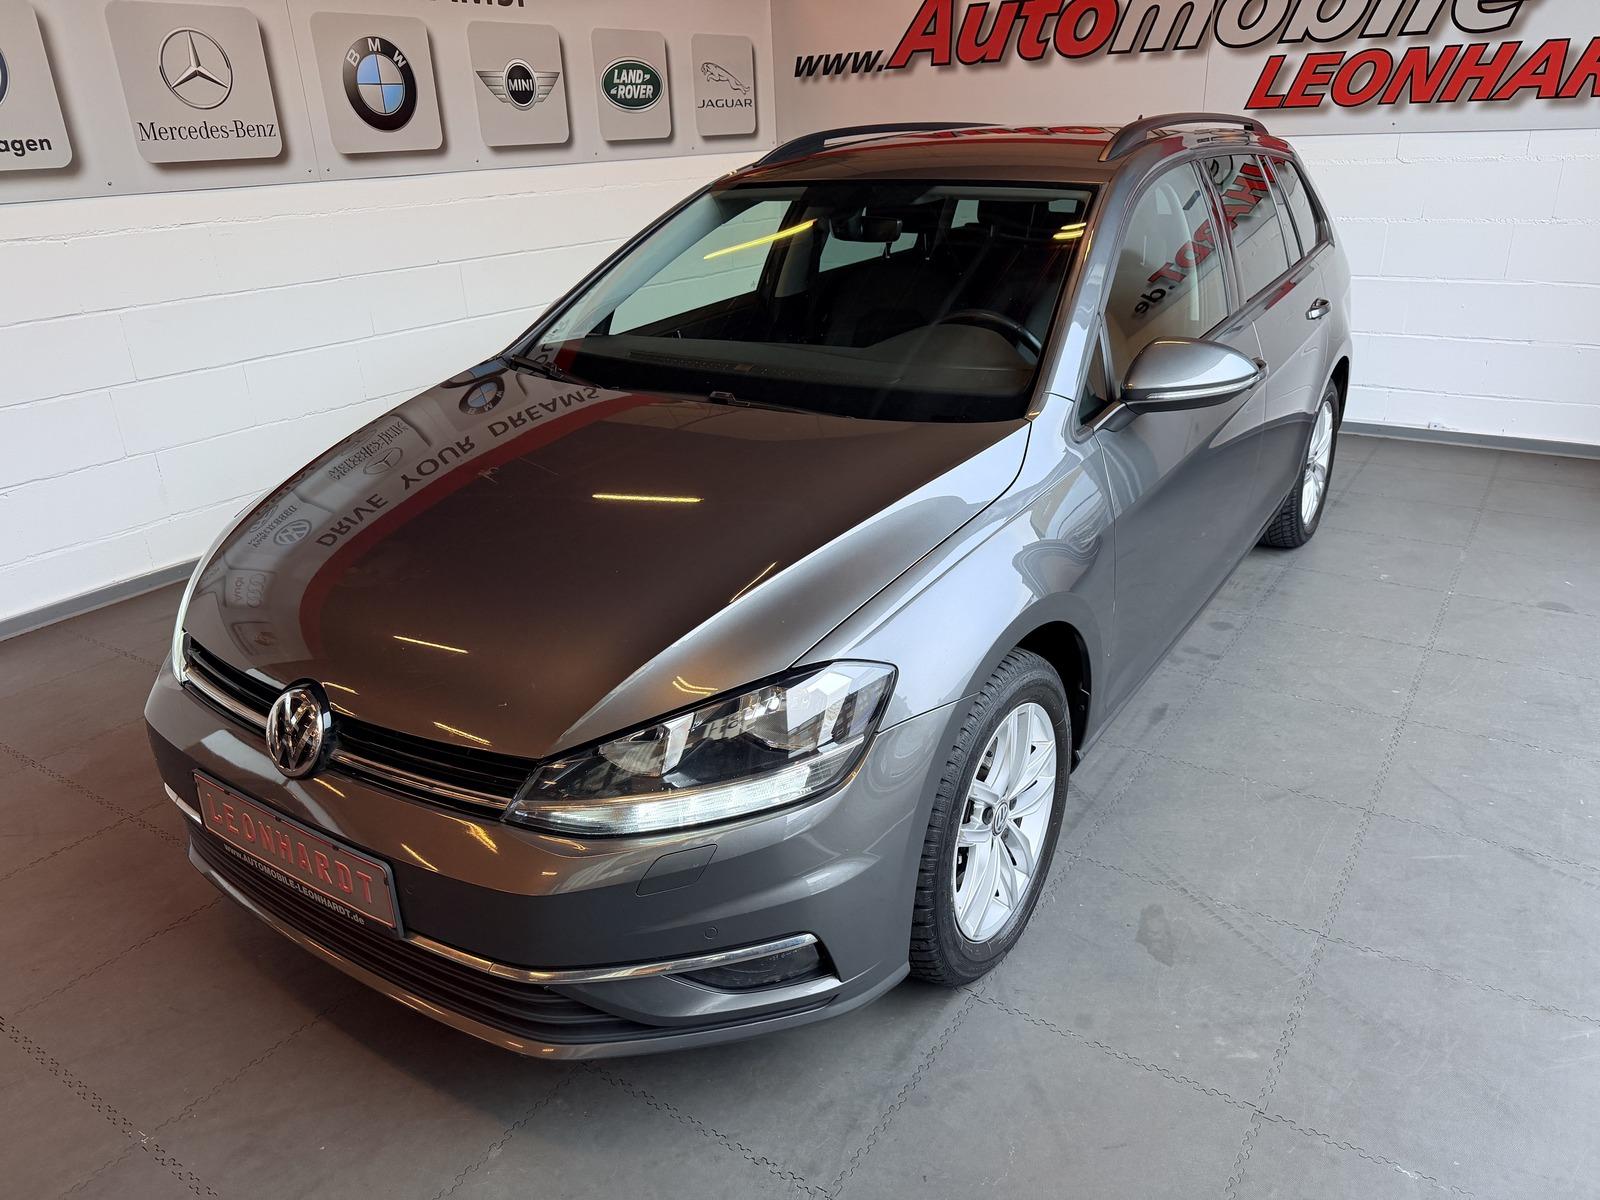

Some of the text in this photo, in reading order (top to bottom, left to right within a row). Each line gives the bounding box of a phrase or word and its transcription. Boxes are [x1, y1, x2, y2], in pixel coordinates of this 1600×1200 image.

[346, 37, 407, 68] BMW
[613, 69, 645, 84] LAND
[508, 78, 534, 92] MINI
[617, 85, 654, 100] ROVER
[697, 98, 753, 109] JAGUAR
[136, 119, 277, 142] Mercedes-Benz
[206, 792, 373, 904] LEONHARDT
